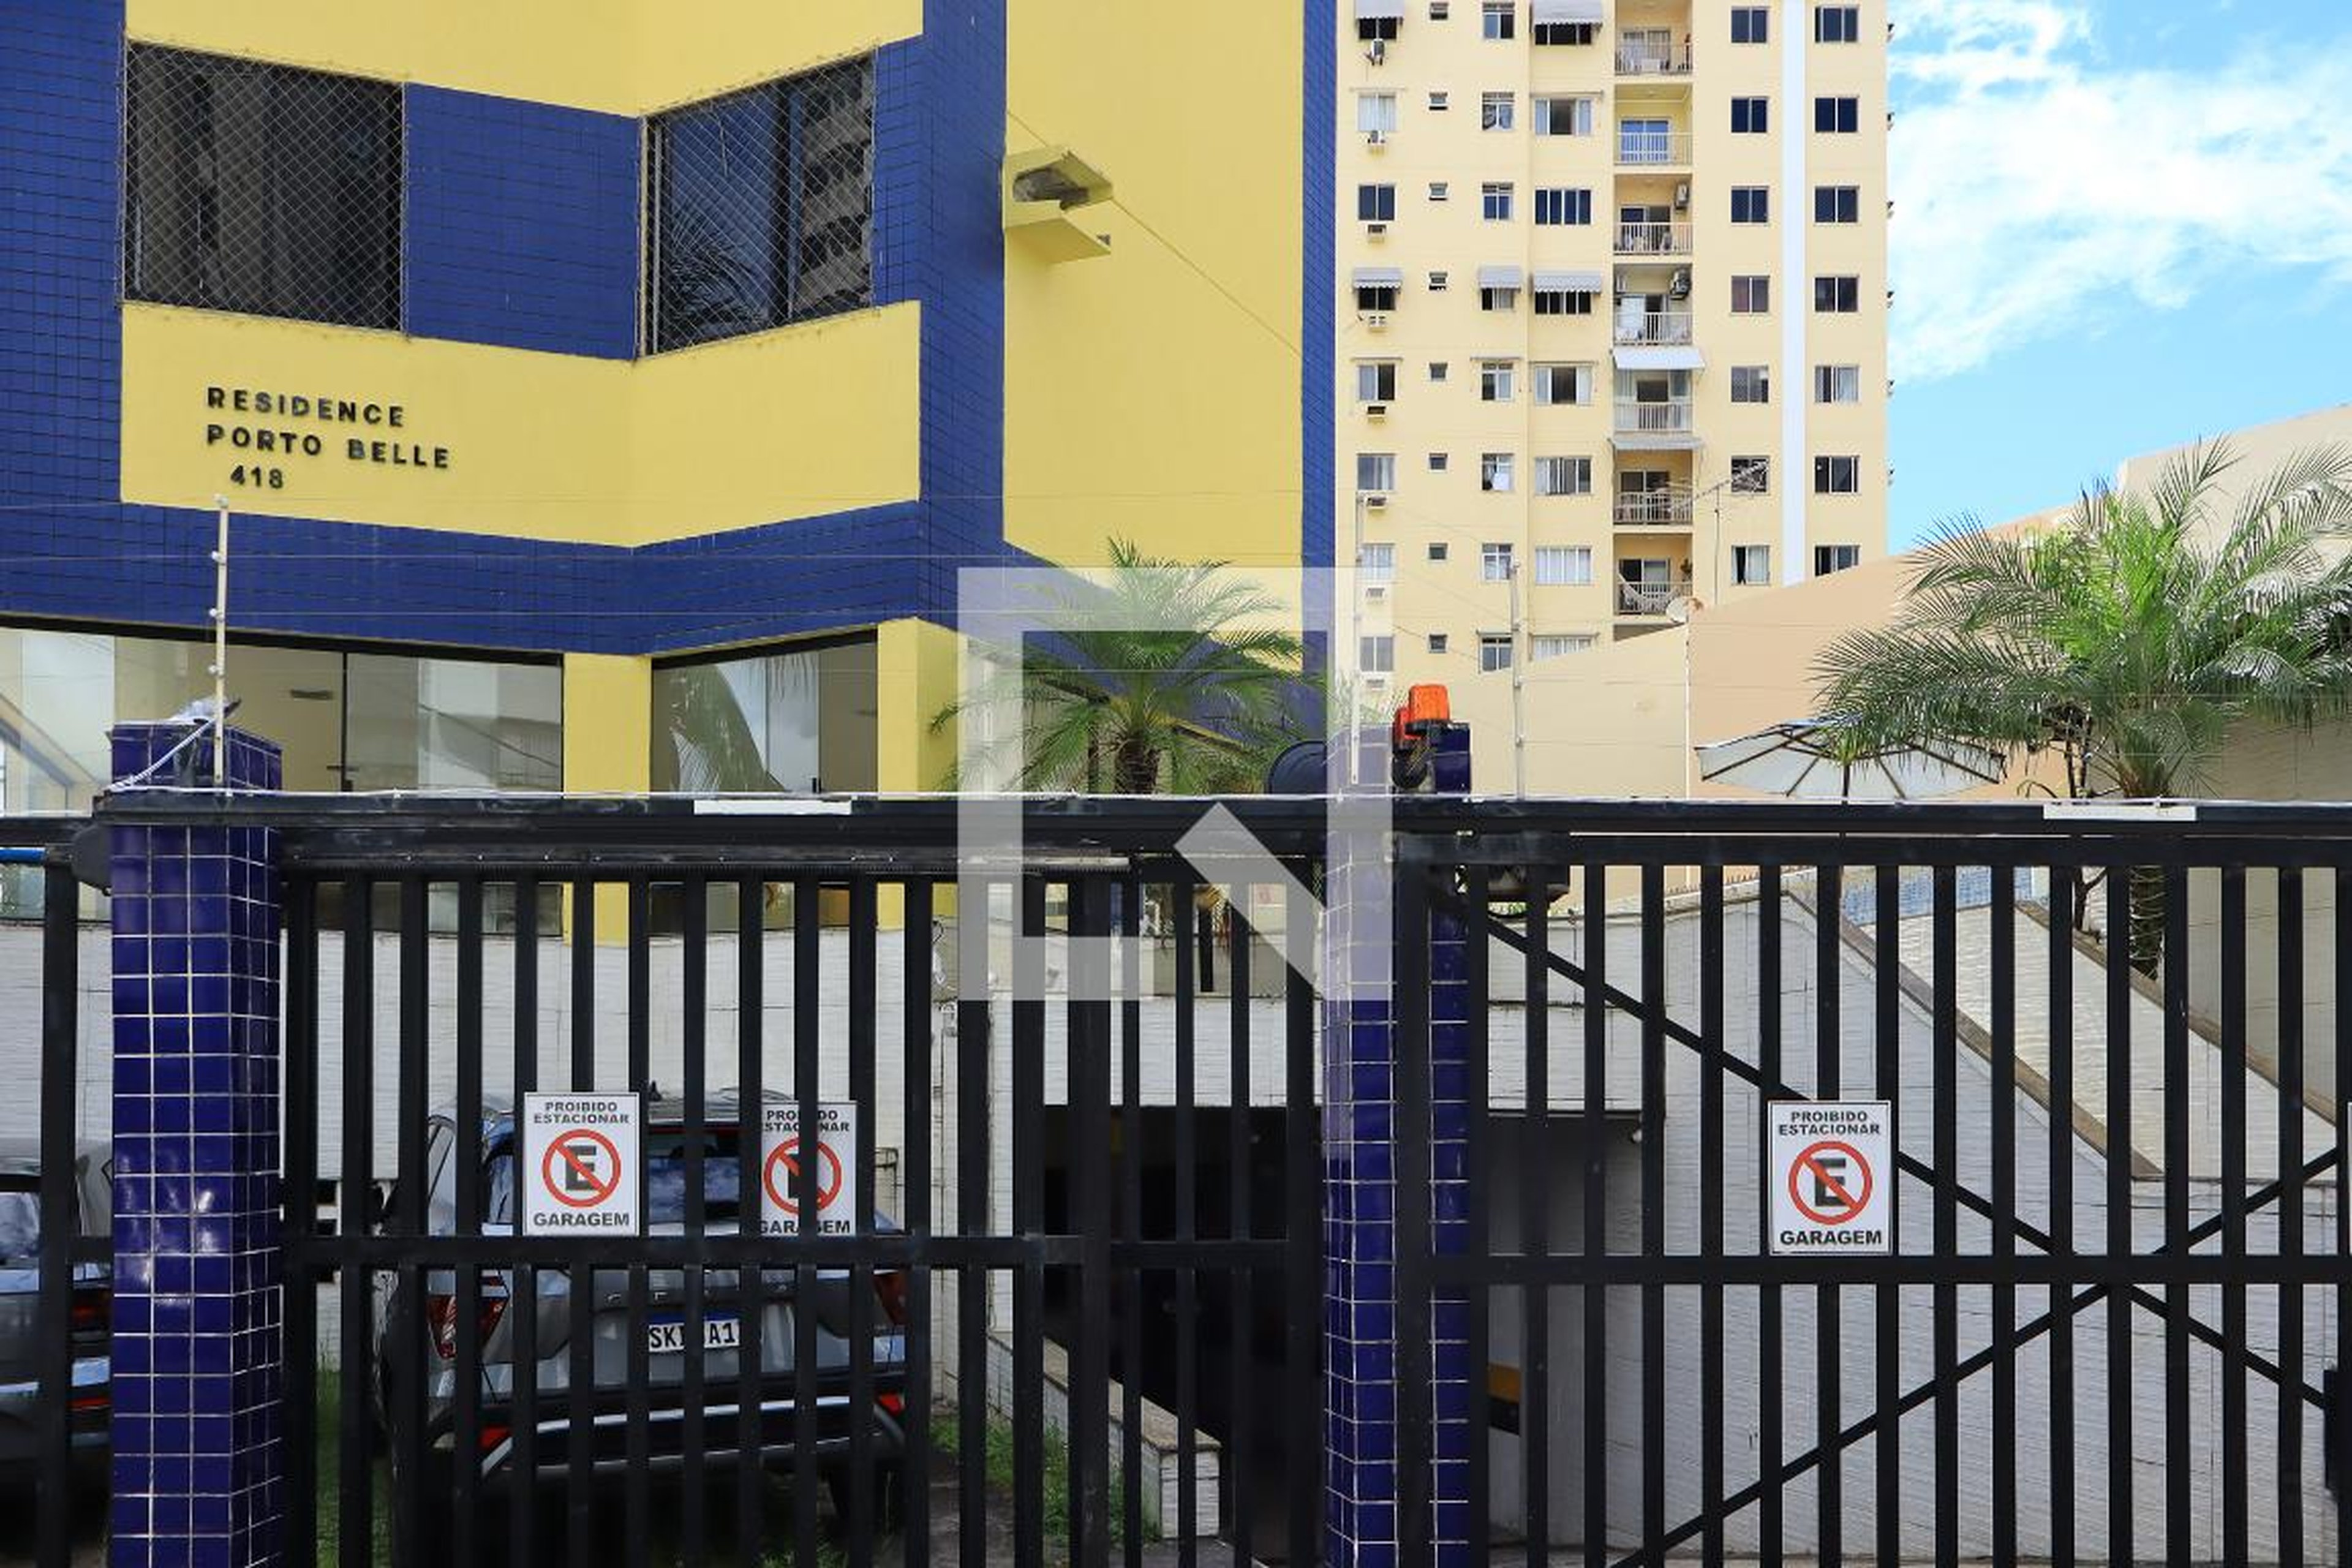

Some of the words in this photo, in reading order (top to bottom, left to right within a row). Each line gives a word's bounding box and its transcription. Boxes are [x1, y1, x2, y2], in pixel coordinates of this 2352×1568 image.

[207, 386, 404, 428] RESIDENCE
[207, 424, 322, 456] PORTO
[347, 438, 450, 469] BELLE
[230, 464, 284, 489] 418
[545, 1102, 617, 1112] PROIBIDO
[533, 1114, 630, 1124] ESTACIONAR
[767, 1110, 839, 1120] PRODO
[1791, 1110, 1868, 1122] PROIBIDO
[764, 1121, 850, 1131] STACNAR
[1779, 1124, 1880, 1135] ESTACIONAR
[533, 1212, 630, 1226] GARAGEM
[760, 1220, 851, 1233] GAREM
[1780, 1230, 1882, 1245] GARAGEM
